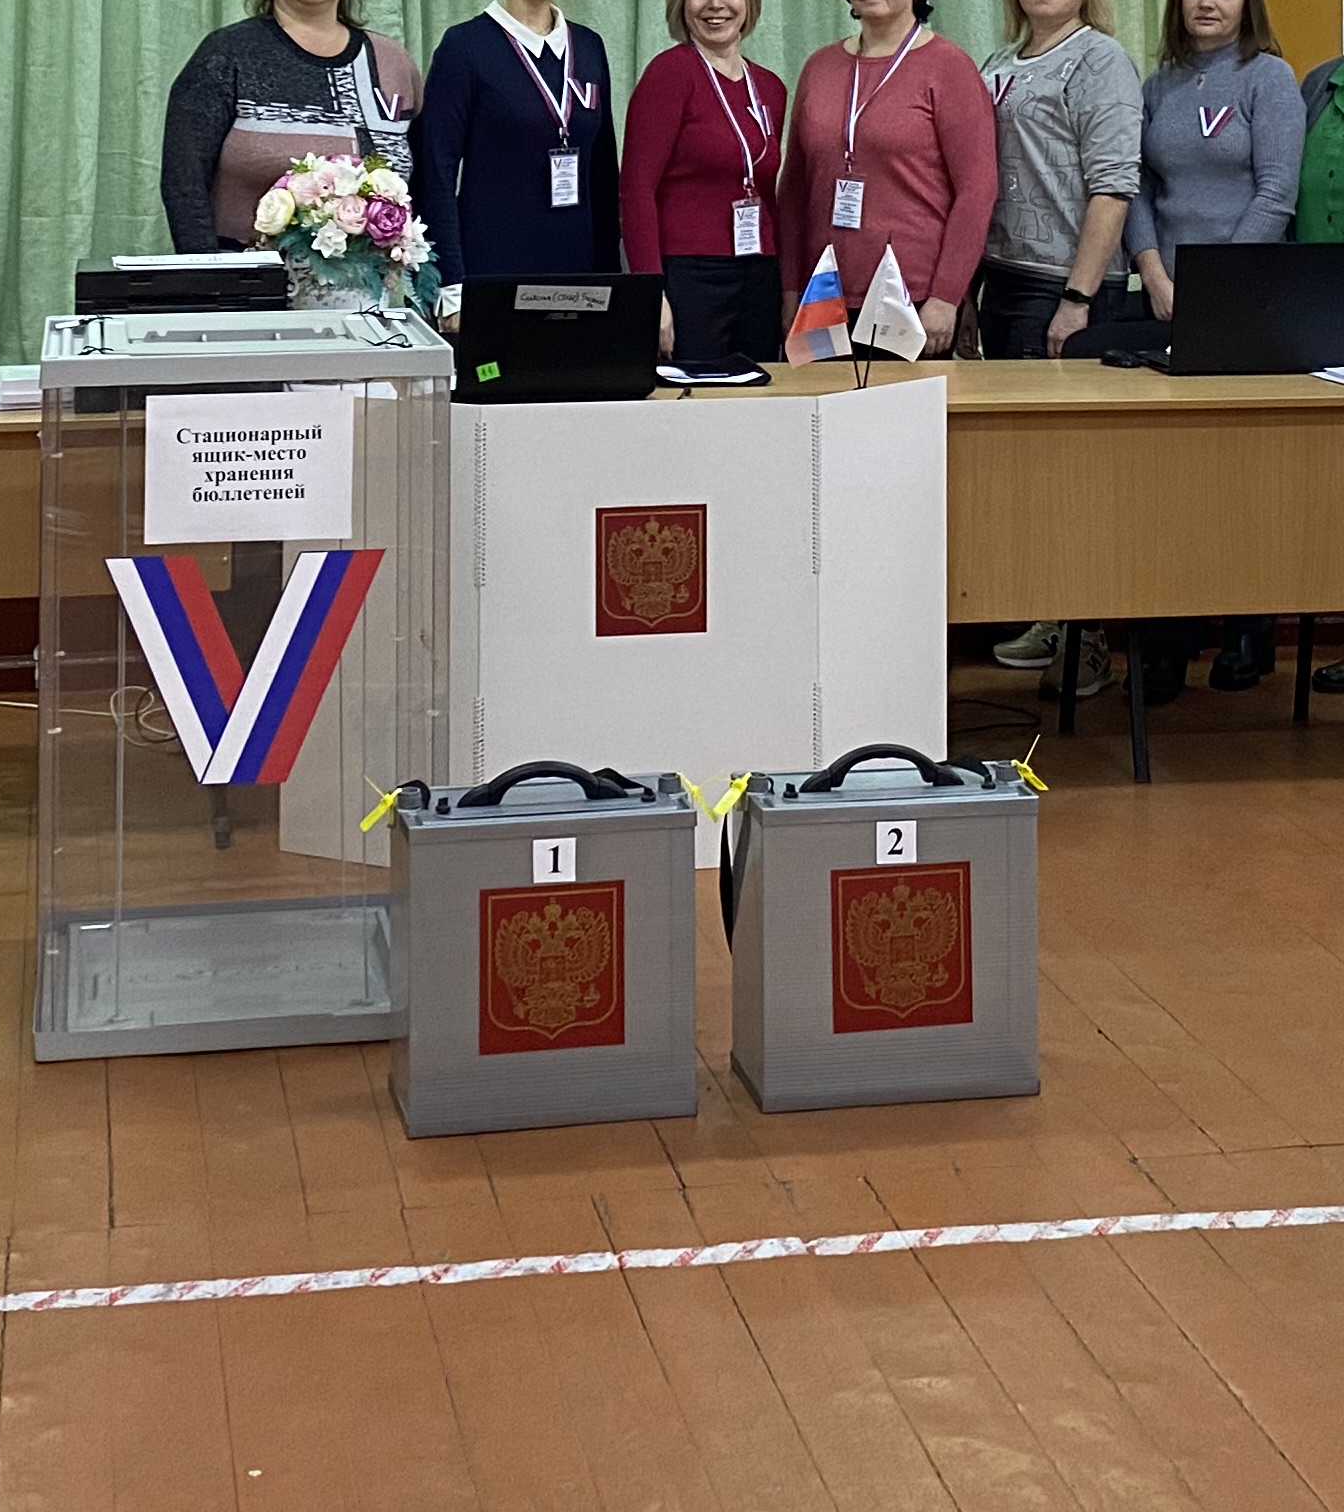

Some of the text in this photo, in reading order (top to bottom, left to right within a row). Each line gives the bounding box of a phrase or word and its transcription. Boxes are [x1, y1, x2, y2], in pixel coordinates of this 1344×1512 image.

[176, 424, 323, 446] Стационарный
[192, 447, 307, 464] ящик-место
[204, 467, 294, 486] хранения
[192, 484, 306, 503] бюллетеней
[887, 827, 904, 855] 2
[547, 844, 562, 874] 1
